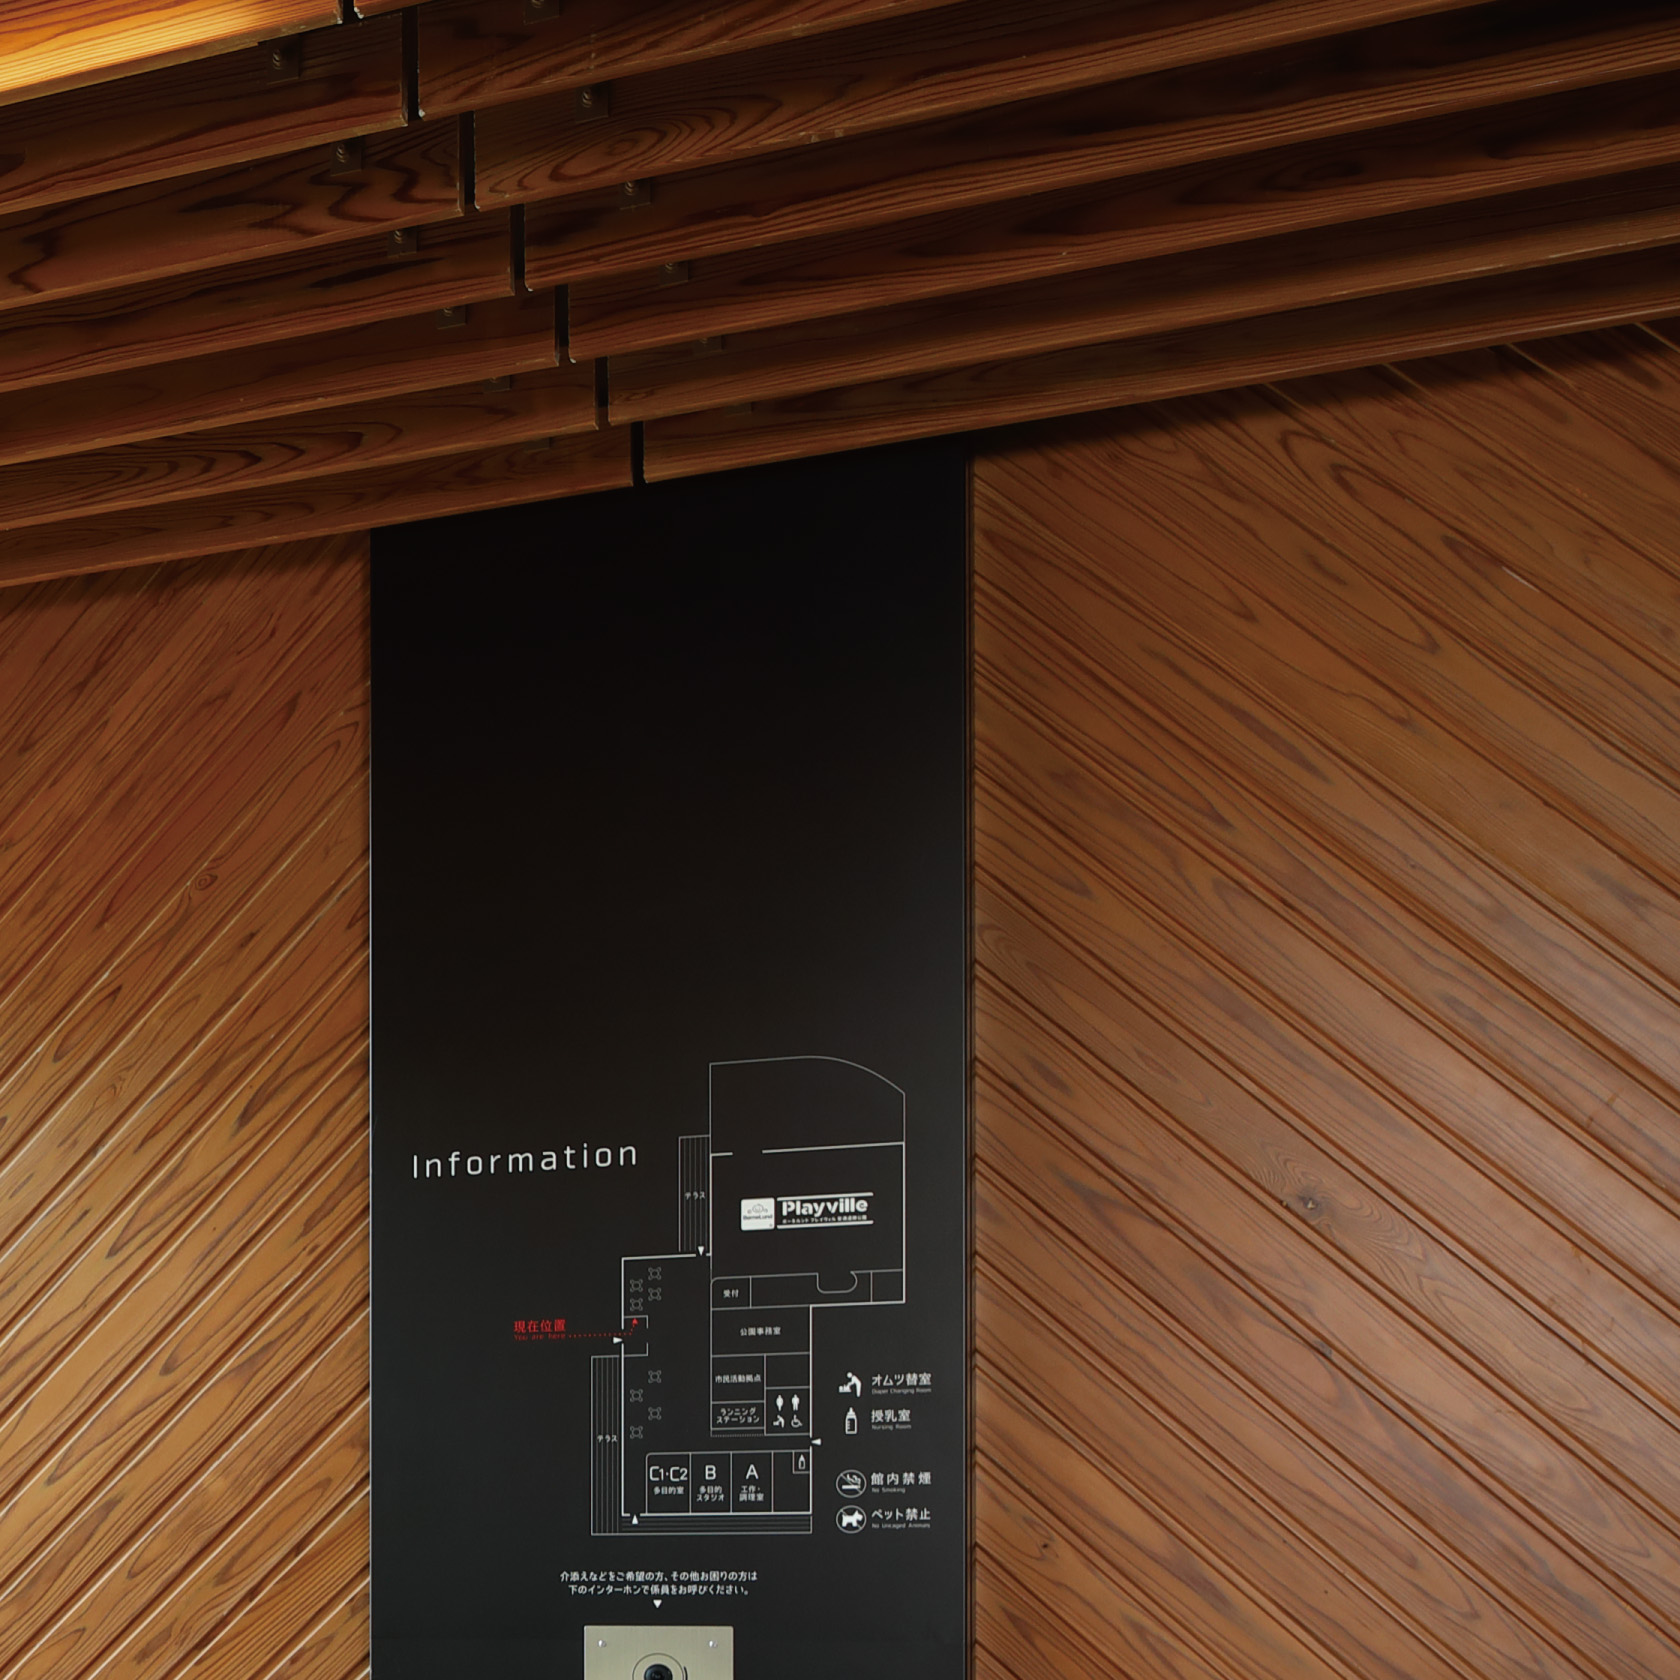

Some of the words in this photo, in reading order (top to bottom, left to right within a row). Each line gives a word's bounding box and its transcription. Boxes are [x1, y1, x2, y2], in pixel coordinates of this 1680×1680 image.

[412, 1142, 638, 1179] Information
[684, 1191, 706, 1200] テラス
[781, 1197, 869, 1218] Playville
[722, 1289, 739, 1299] 受付
[513, 1318, 566, 1334] 現在位置
[871, 1373, 932, 1387] オムツ替室
[719, 1406, 757, 1416] ランニング
[871, 1409, 911, 1423] 授乳室
[715, 1415, 760, 1425] ステーション
[596, 1434, 618, 1444] テラス
[705, 1465, 717, 1481] B
[745, 1464, 759, 1480] A
[871, 1471, 932, 1486] 館内禁煙
[653, 1486, 684, 1496] 多目的室
[699, 1485, 722, 1495] 多目的
[871, 1507, 931, 1522] ペット禁止
